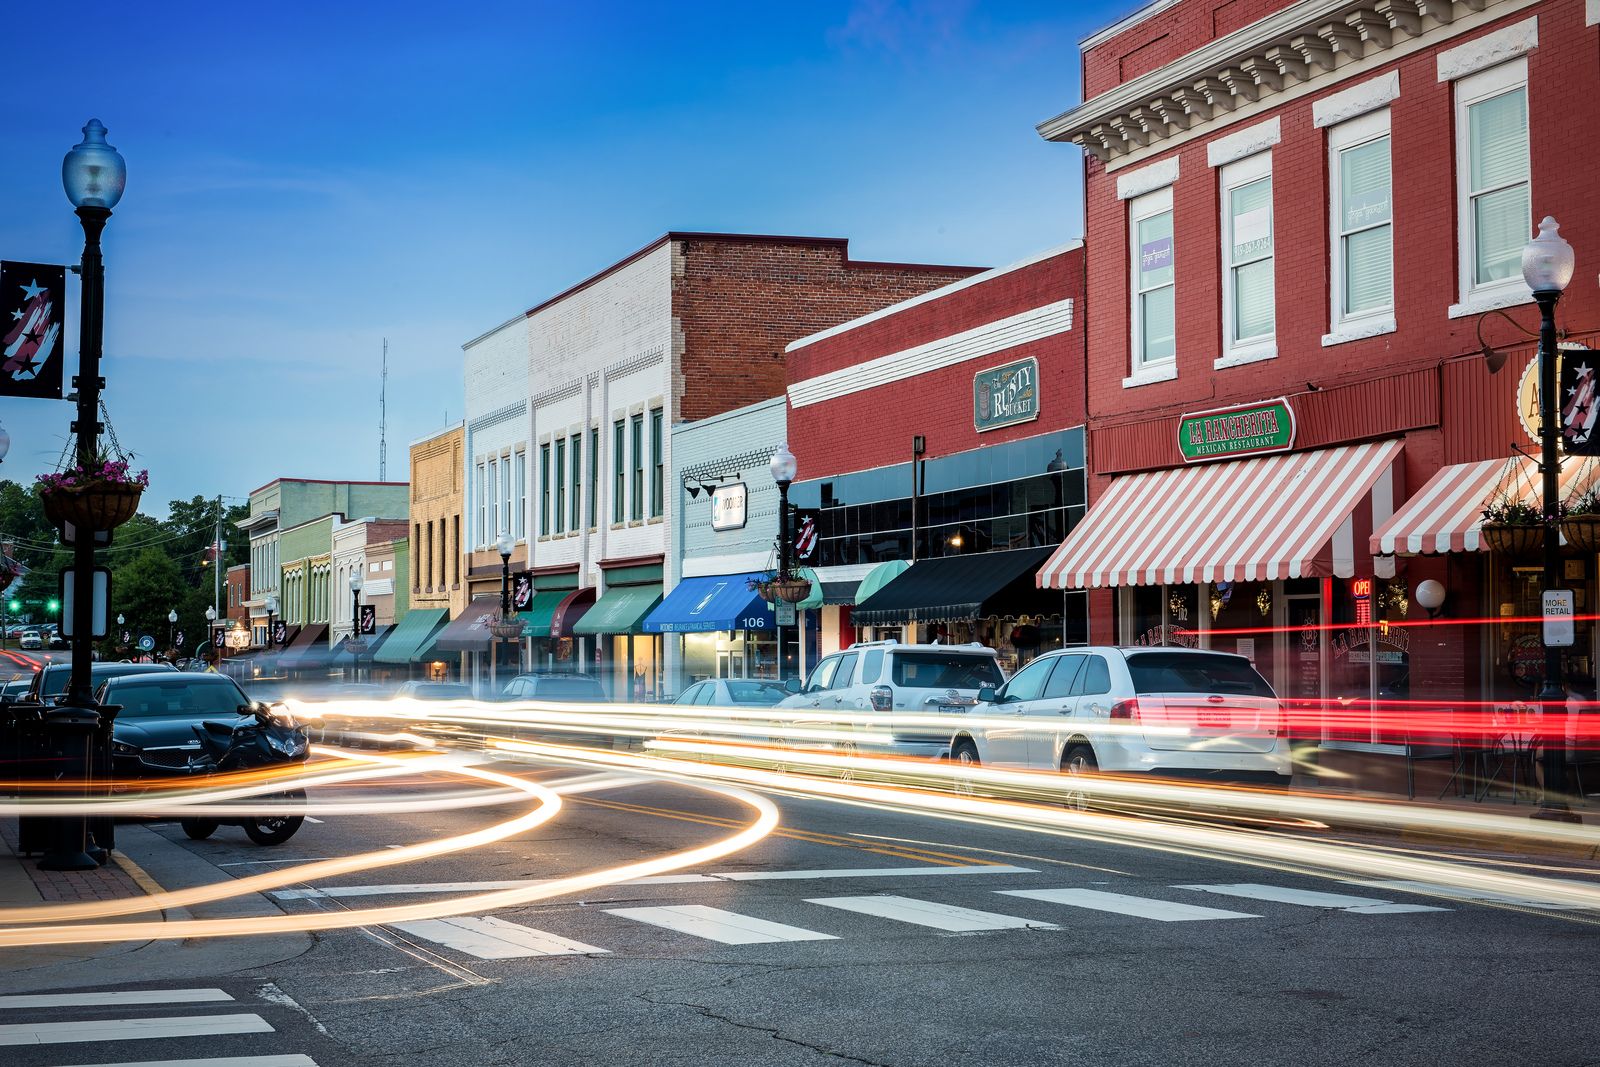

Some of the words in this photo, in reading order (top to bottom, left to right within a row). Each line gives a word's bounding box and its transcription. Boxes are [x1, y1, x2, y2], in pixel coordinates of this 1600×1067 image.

[993, 366, 1032, 418] RUSTY
[1005, 399, 1032, 417] BUCKET
[1188, 422, 1204, 445] LA
[1206, 409, 1279, 443] RANCHERITA
[1196, 442, 1227, 455] MEXICAN
[1229, 435, 1275, 451] RESTAURANT
[1545, 599, 1567, 607] MORE
[1545, 607, 1571, 615] RETAIL
[743, 617, 765, 628] 106
[1331, 633, 1348, 658] LA
